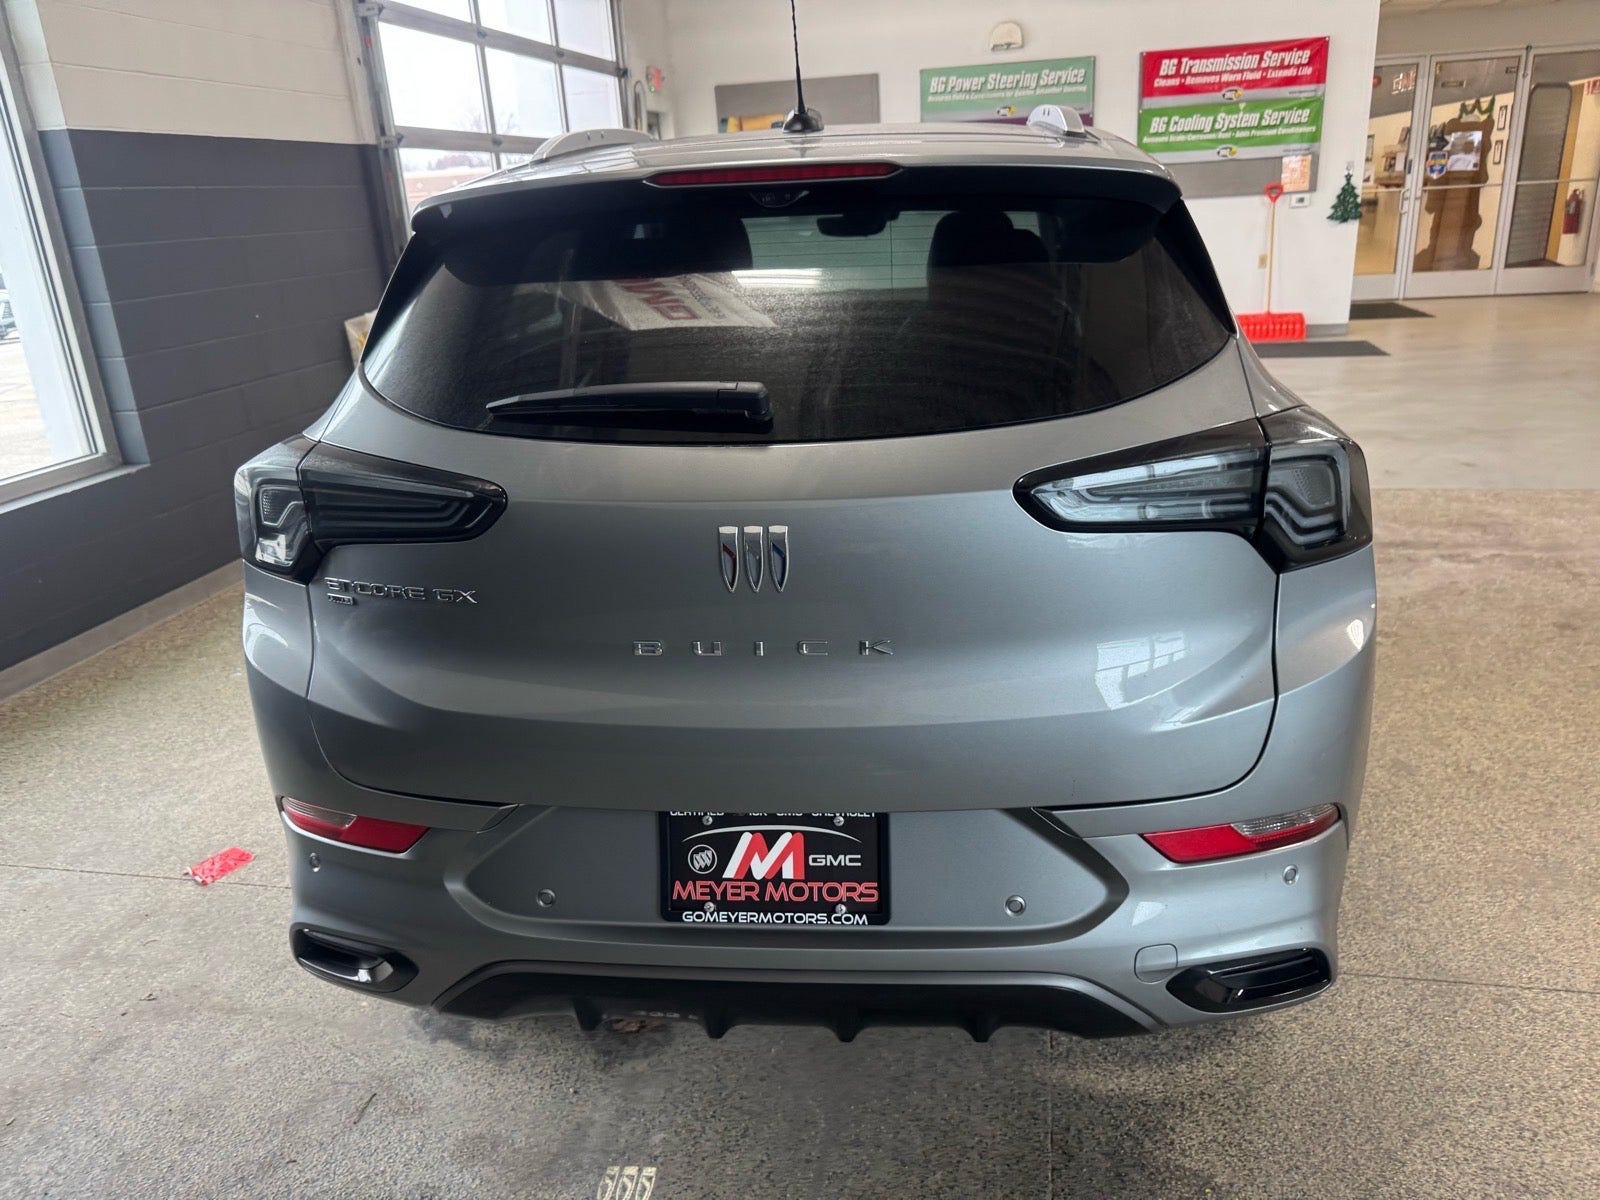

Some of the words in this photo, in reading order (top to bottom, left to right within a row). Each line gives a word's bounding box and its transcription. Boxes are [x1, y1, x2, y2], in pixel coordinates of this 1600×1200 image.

[1159, 58, 1177, 76] BG
[1180, 52, 1260, 75] Transmission
[1261, 48, 1311, 68] Service
[949, 75, 985, 93] Power
[987, 71, 1038, 90] Steering
[1039, 67, 1086, 86] Service
[1267, 67, 1297, 79] Extends
[1149, 116, 1168, 133] BG
[1168, 114, 1214, 133] Cooling
[1215, 112, 1260, 132] System
[1261, 107, 1311, 126] Service
[432, 588, 478, 604] GX
[632, 640, 894, 656] BUICK
[808, 854, 862, 867] GMC
[672, 880, 760, 902] MEYER
[764, 881, 879, 903] MOTORS
[682, 911, 869, 925] GOMEYERMOTORS.COM
